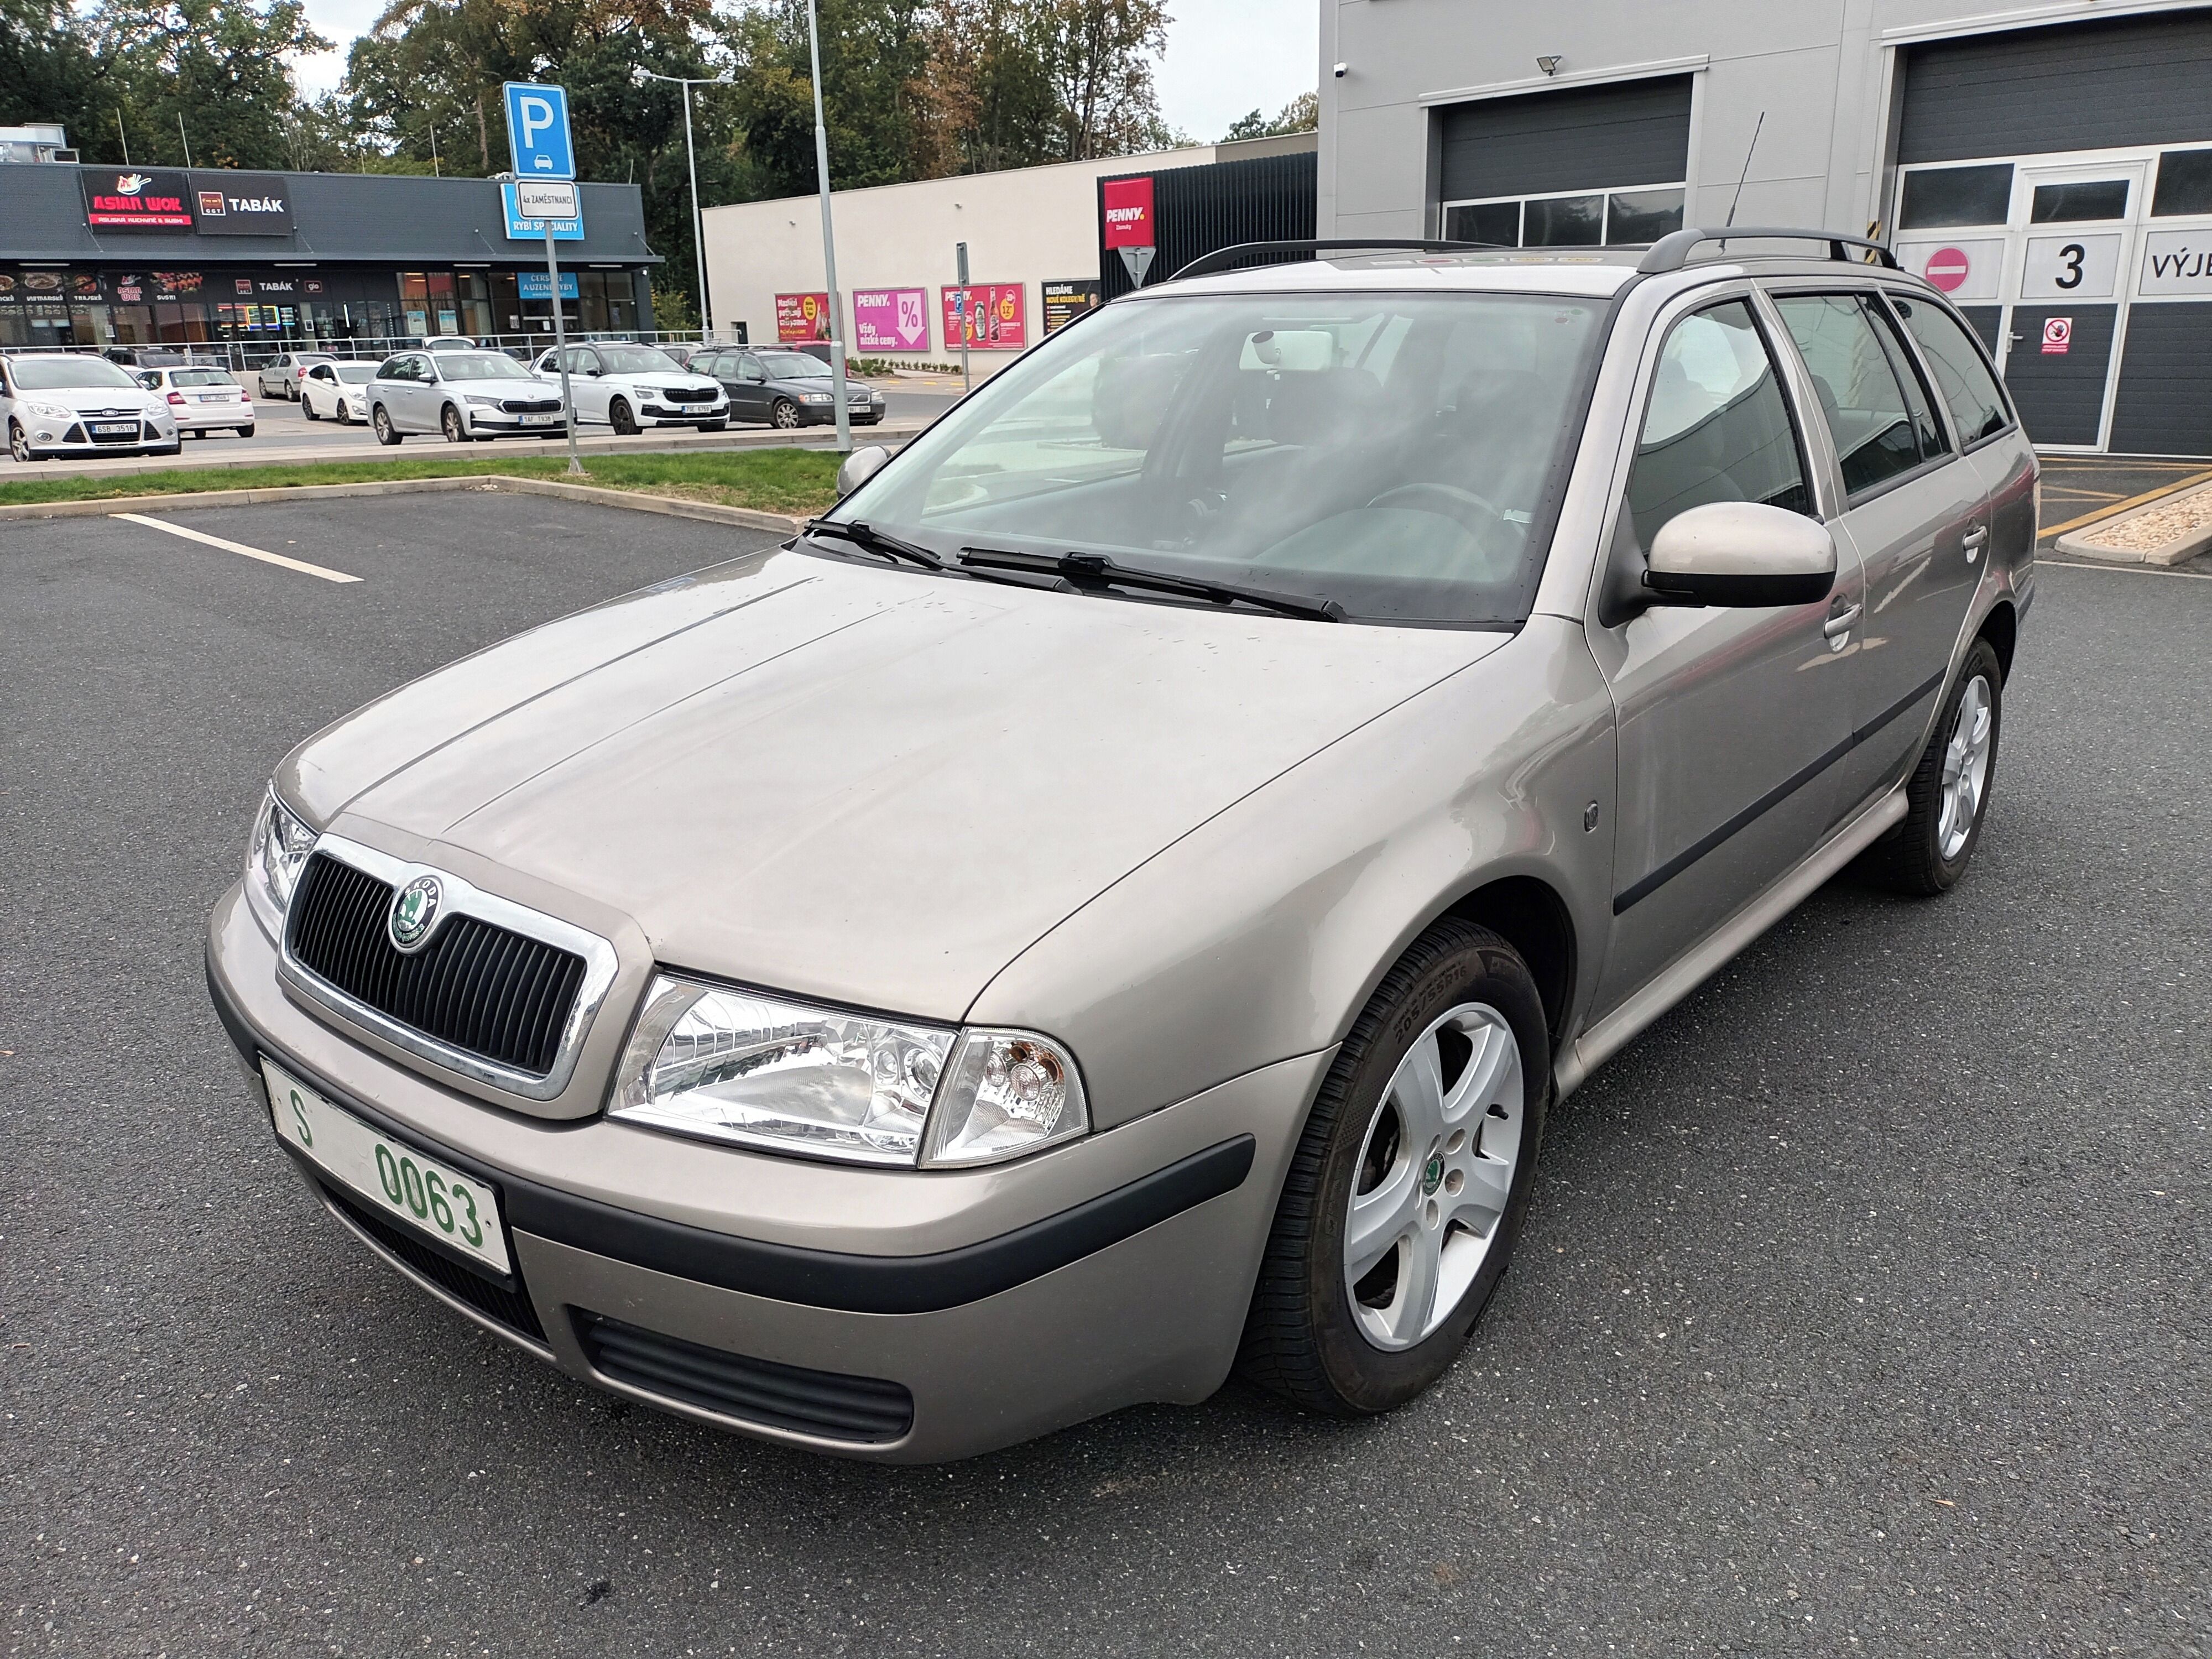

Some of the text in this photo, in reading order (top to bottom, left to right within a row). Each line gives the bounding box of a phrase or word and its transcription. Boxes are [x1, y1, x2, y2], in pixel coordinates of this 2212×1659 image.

[520, 97, 554, 148] P
[94, 196, 182, 211] ASIAN WOK
[228, 197, 284, 212] TABÁK
[531, 194, 573, 204] ZAMĚSTNANCI
[513, 220, 578, 232] RYBÍ SPIALITY
[2055, 244, 2085, 289] 3
[531, 273, 564, 281] ČERSÉ
[259, 281, 294, 291] TABÁK
[1046, 284, 1073, 295] HLEDÁME
[858, 322, 876, 336] Vždy
[860, 333, 898, 347] nízké ceny.
[290, 1089, 483, 1248] S 0063
